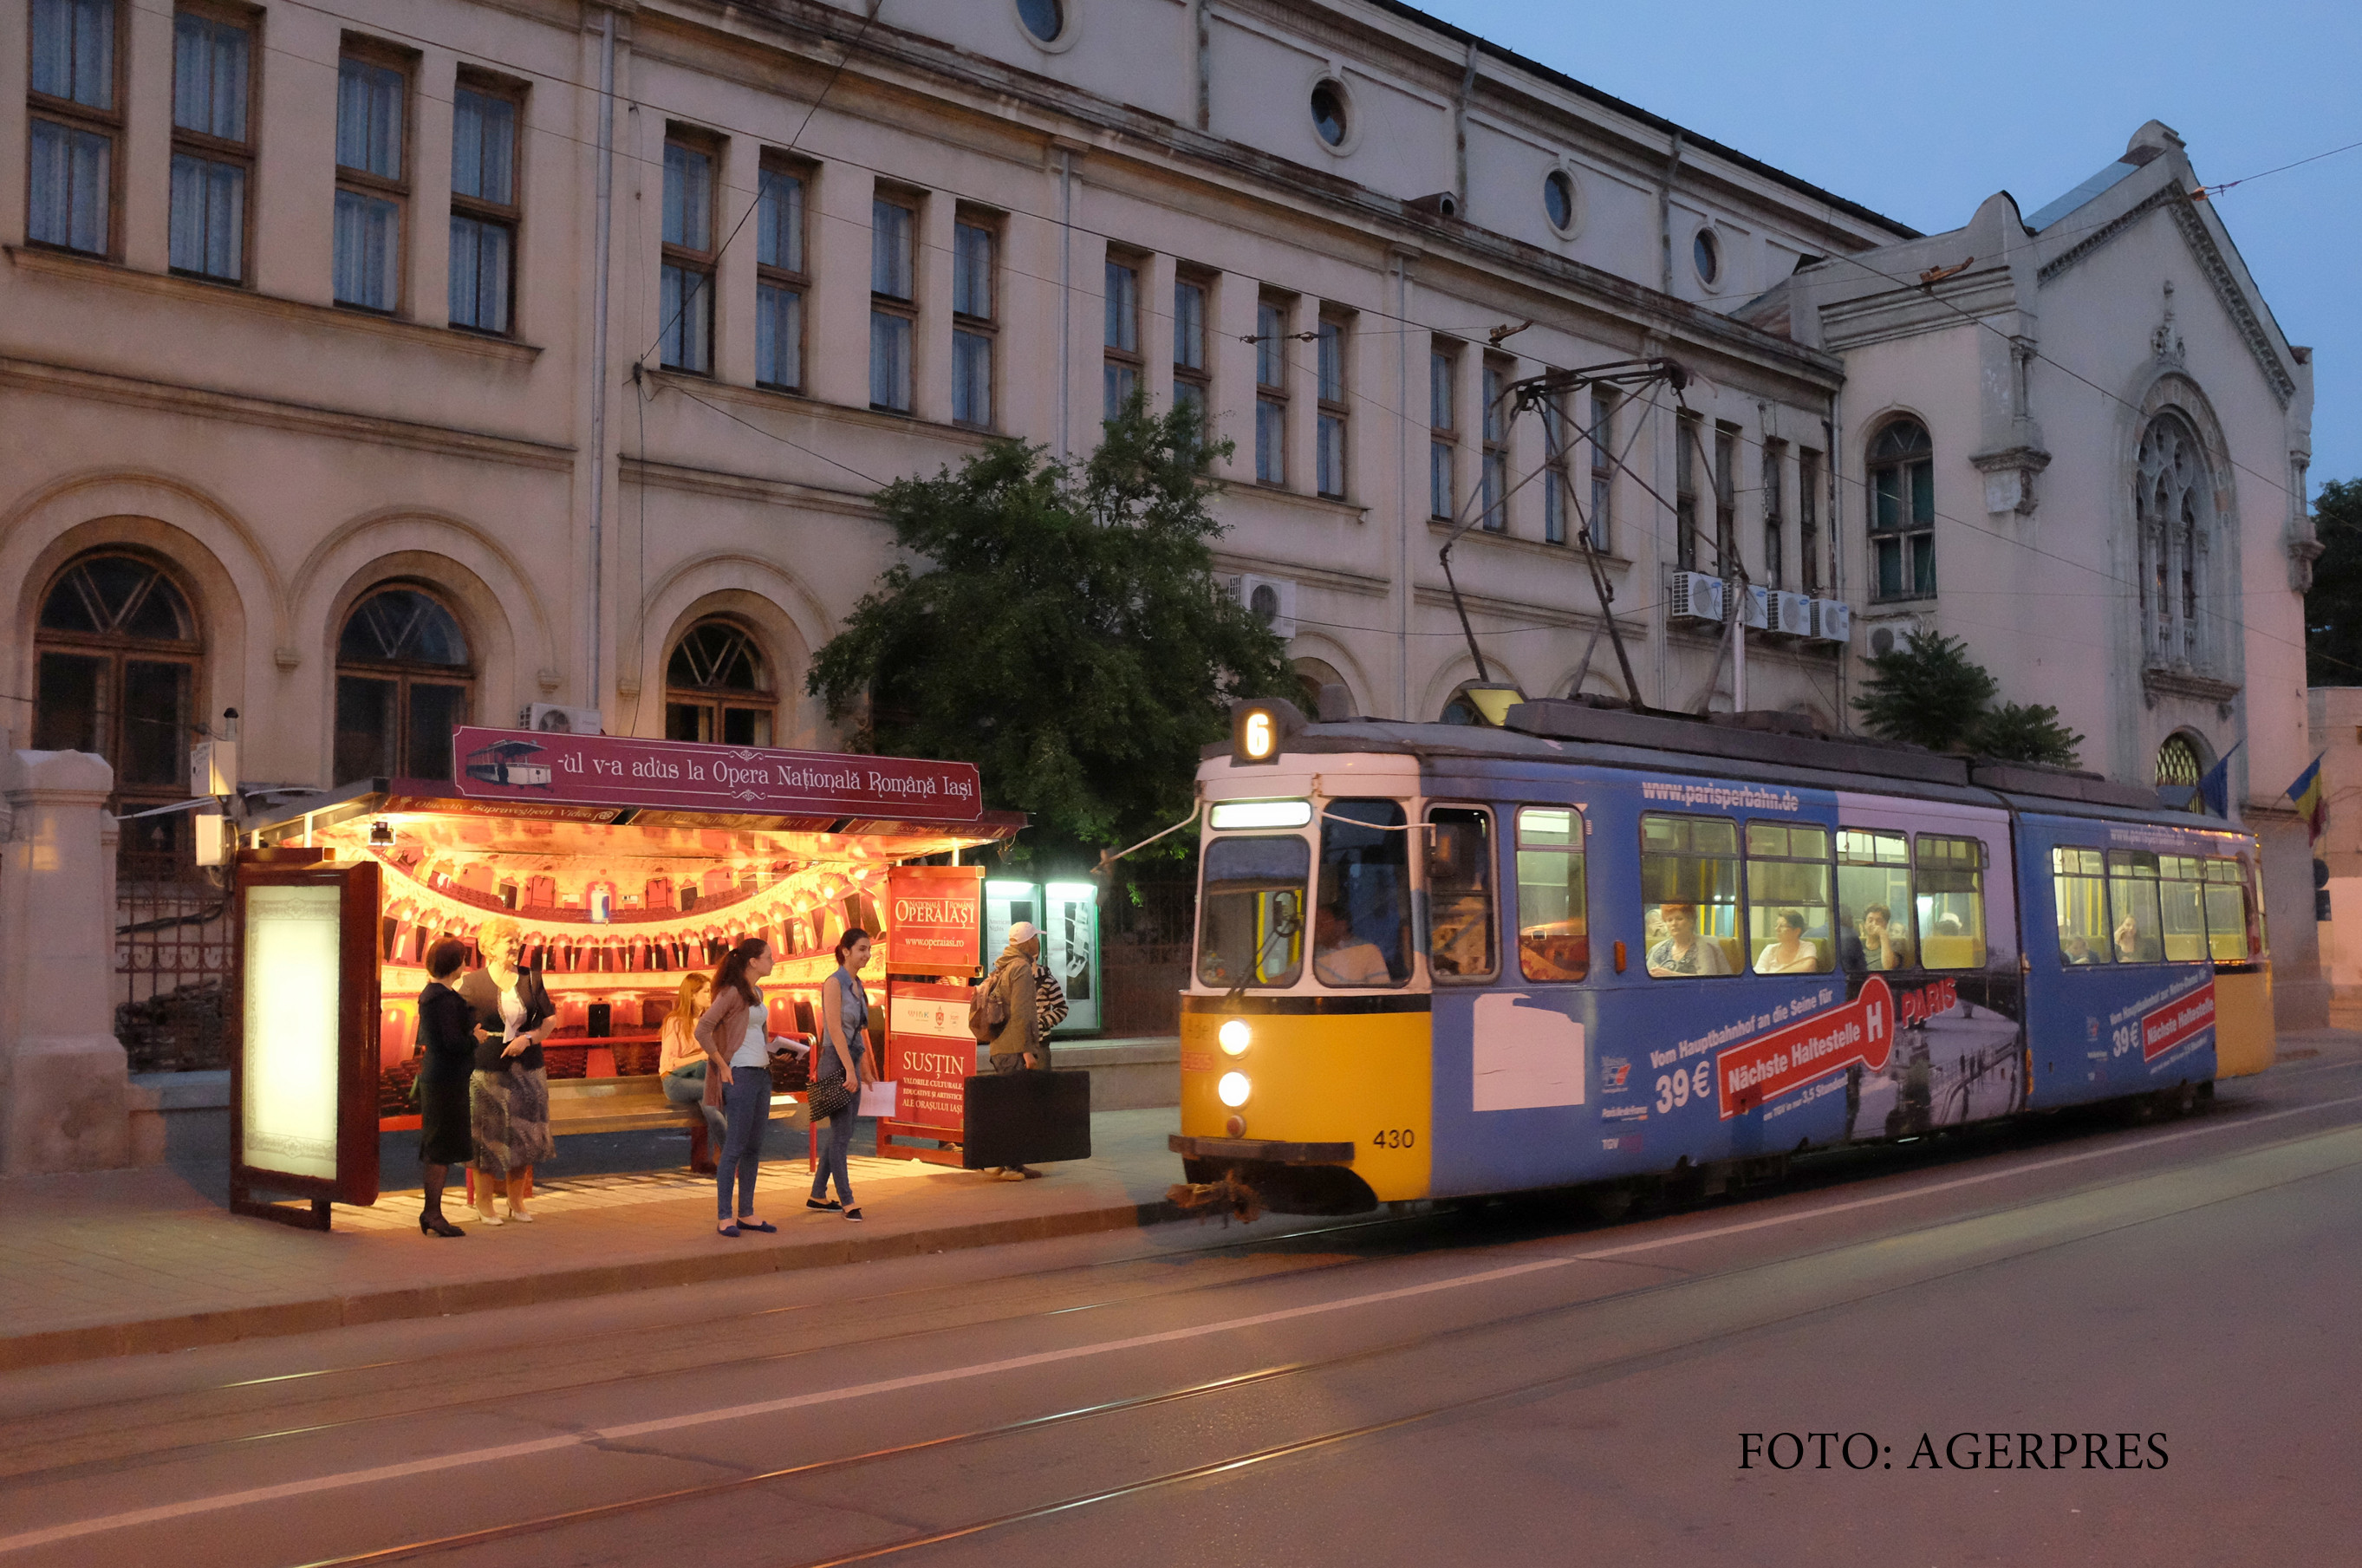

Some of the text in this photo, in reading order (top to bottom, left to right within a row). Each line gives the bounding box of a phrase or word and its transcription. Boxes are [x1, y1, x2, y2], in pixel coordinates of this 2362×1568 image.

[1246, 713, 1270, 757] 6
[592, 758, 624, 777] v-a
[632, 757, 680, 779] adus
[686, 759, 706, 781] la
[713, 760, 770, 787] Opera
[868, 771, 937, 798] Română
[471, 803, 555, 817] Supravegheat
[560, 808, 592, 820] Video
[1642, 782, 1799, 812] www.parisperbahn.de
[905, 936, 965, 950] www.operaiasi.ro
[1901, 978, 1957, 1030] PARIS
[1649, 1047, 1678, 1070] Vom
[1678, 1014, 1757, 1059] Hauptbahnhof
[1757, 1013, 1771, 1030] an
[1773, 1005, 1789, 1024] die
[1790, 996, 1818, 1016] Seine
[1819, 988, 1833, 1006] für
[2146, 997, 2215, 1045] Nächste Haltestelle
[1728, 1000, 1884, 1095] Nächste Haltestelle H
[902, 1087, 931, 1097] EDUCATIVE
[936, 1091, 964, 1101] ARTISTICE
[903, 1077, 964, 1090] VALORILE CULTURALE,
[902, 1098, 915, 1108] ALE
[915, 1099, 949, 1112] ORAȘULUI
[1373, 1129, 1415, 1149] 430
